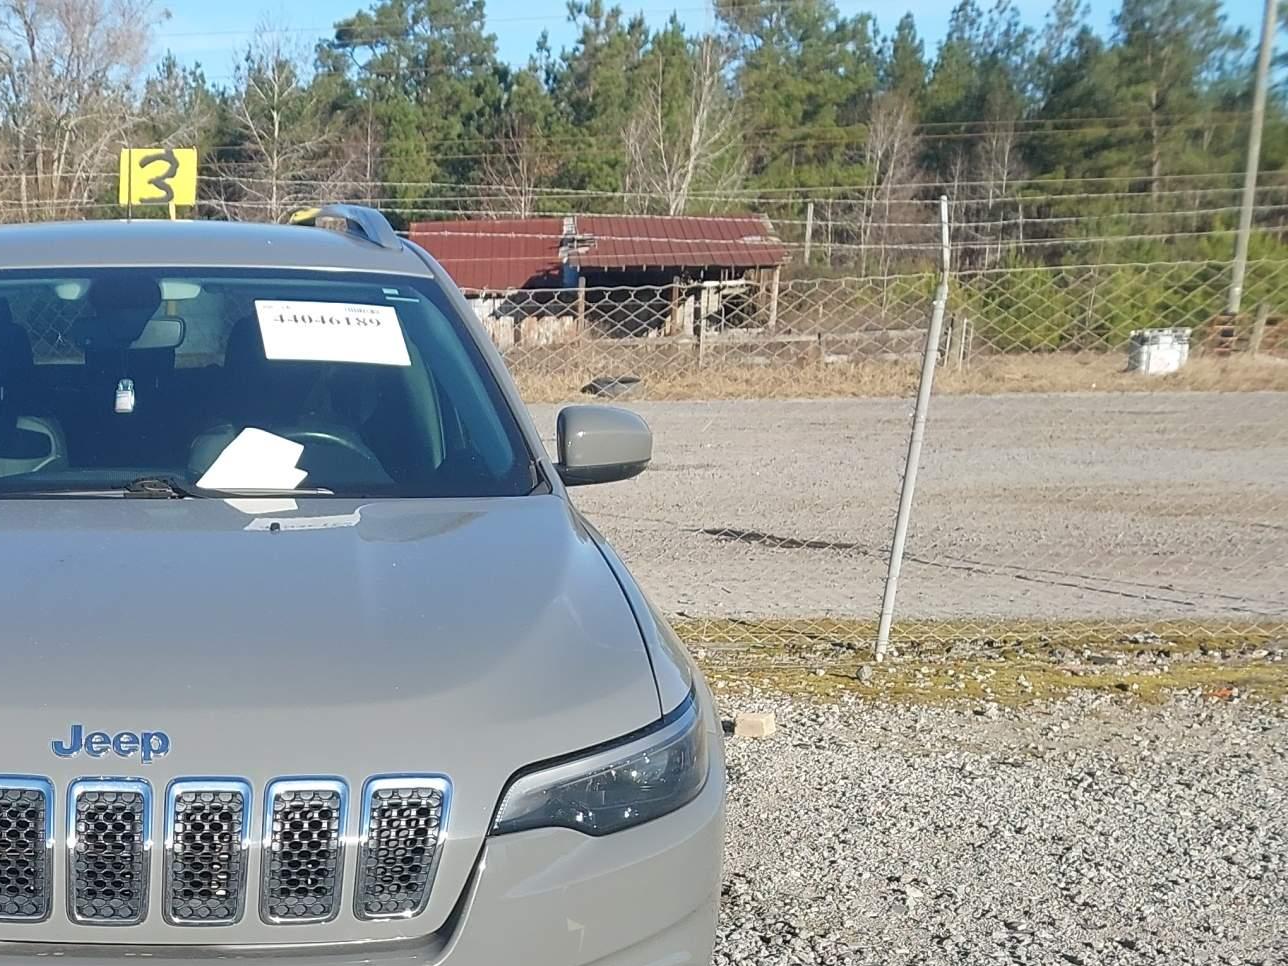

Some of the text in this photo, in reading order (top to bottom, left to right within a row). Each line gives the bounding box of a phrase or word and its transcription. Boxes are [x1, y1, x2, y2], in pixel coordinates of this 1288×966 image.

[139, 151, 179, 202] 3
[273, 314, 382, 328] 44046189
[52, 724, 171, 764] Jeep
